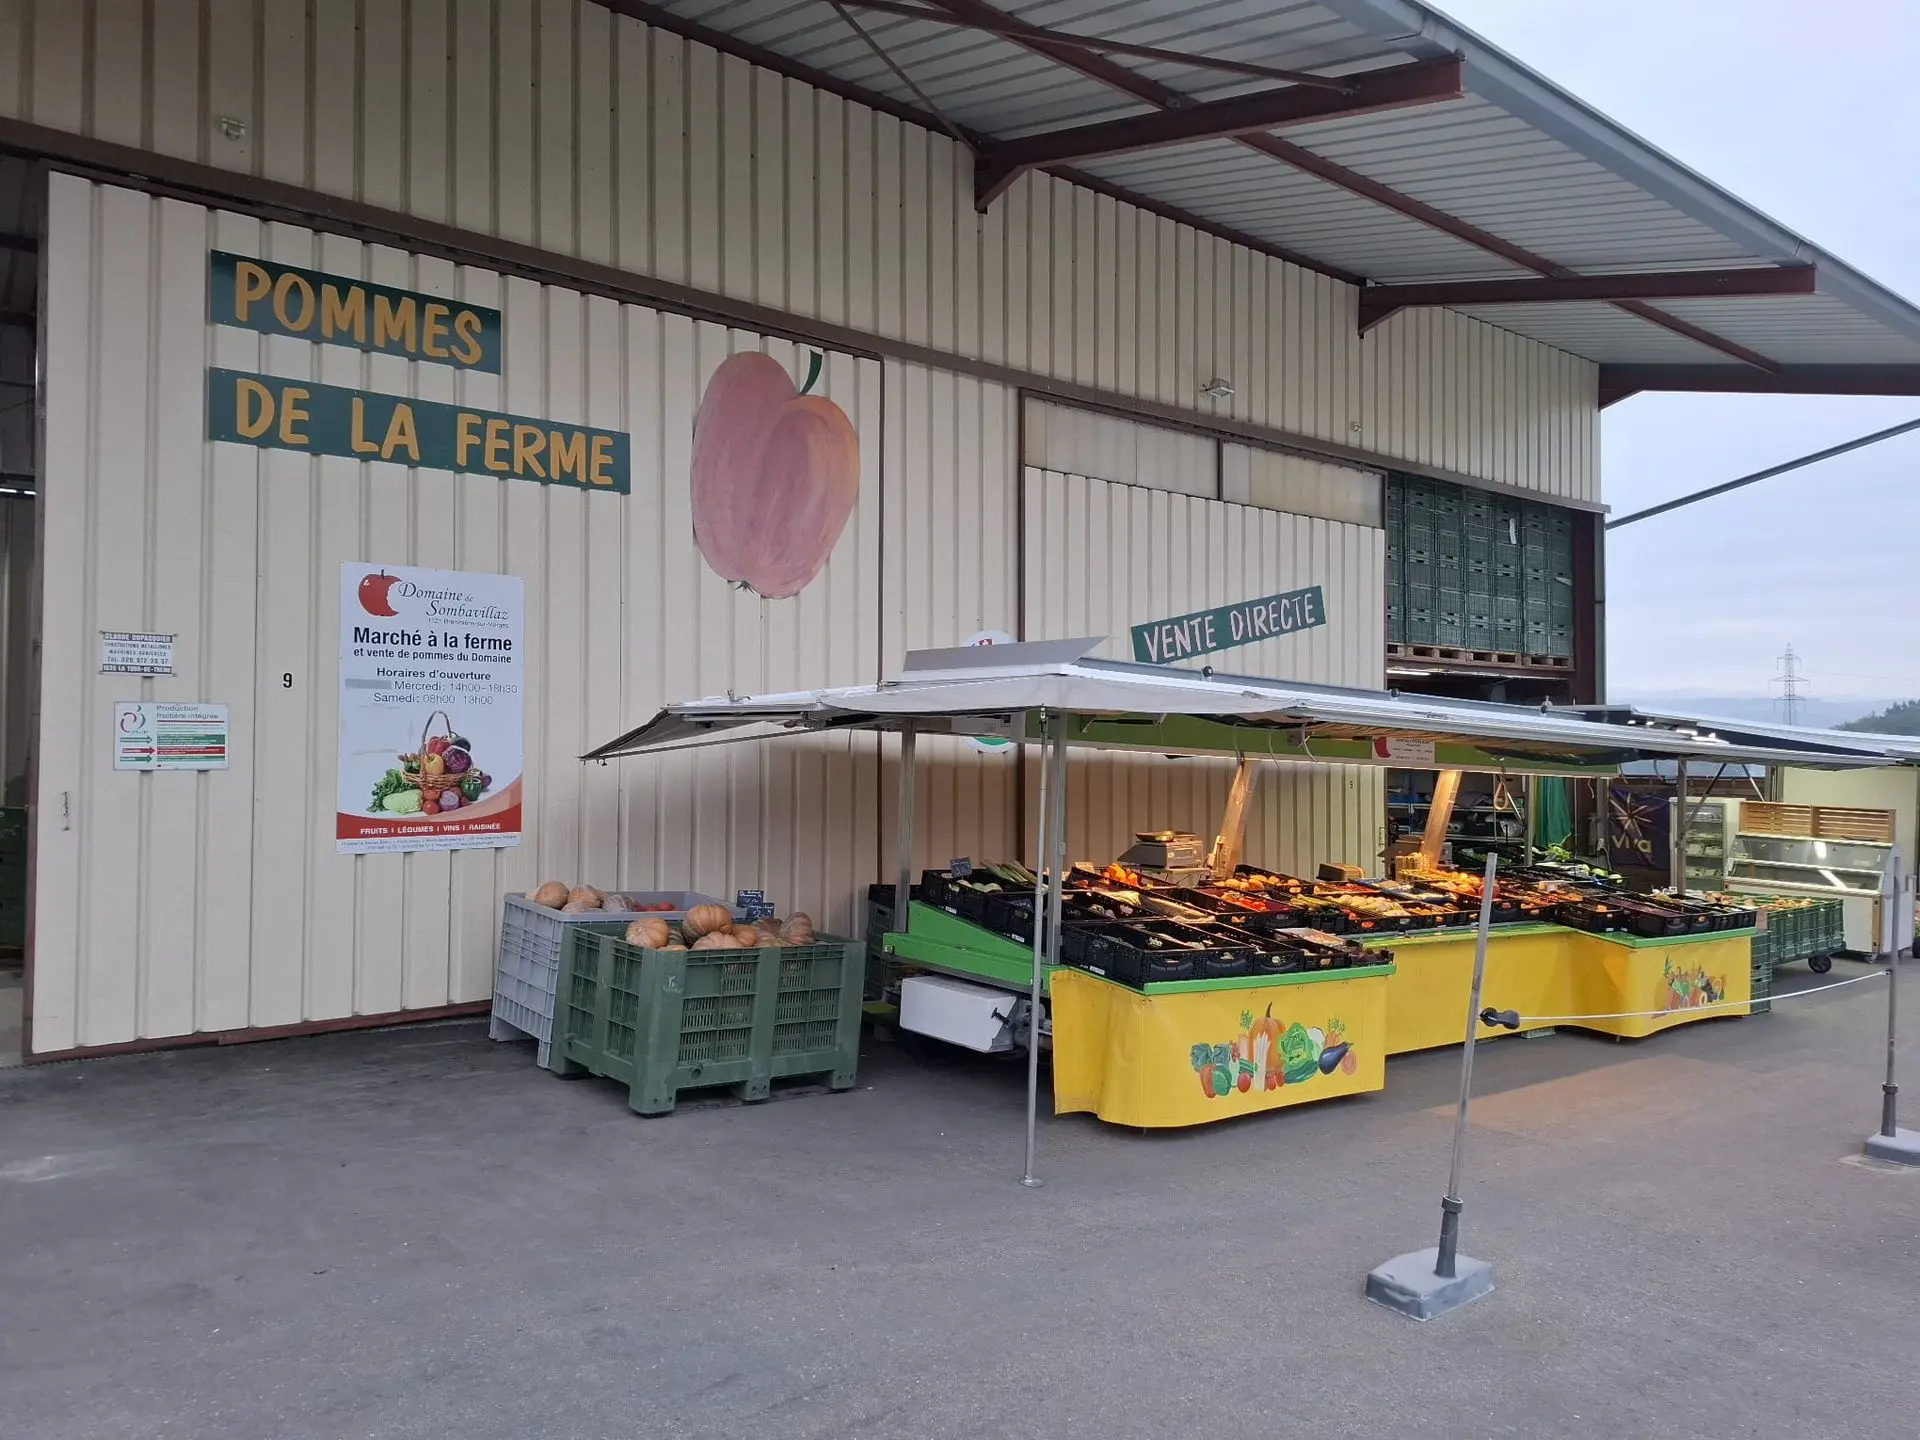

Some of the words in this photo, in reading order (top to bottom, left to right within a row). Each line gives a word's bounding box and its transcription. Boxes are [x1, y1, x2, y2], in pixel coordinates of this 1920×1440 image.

[234, 261, 483, 365] POMMES
[235, 378, 311, 444] DE
[351, 396, 420, 461] LA
[456, 412, 614, 485] FERME
[398, 581, 463, 602] Domaine
[426, 600, 509, 620] Sombavillaz
[1143, 614, 1217, 662] VENTE
[1229, 593, 1315, 640] DIRECTE
[353, 626, 422, 646] Marché
[427, 630, 438, 647] à
[444, 632, 458, 648] la
[464, 633, 512, 651] ferme
[353, 647, 364, 656] et
[367, 649, 394, 659] vente
[397, 650, 410, 659] de
[412, 651, 454, 662] pommes
[457, 652, 469, 662] du
[471, 653, 512, 664] Domaine
[283, 672, 293, 689] 9
[376, 667, 425, 678] Horaires
[428, 670, 491, 681] d'ouverture
[360, 827, 388, 836] FRUITS
[397, 825, 434, 834] LÉGUMES
[443, 824, 460, 832] VINS
